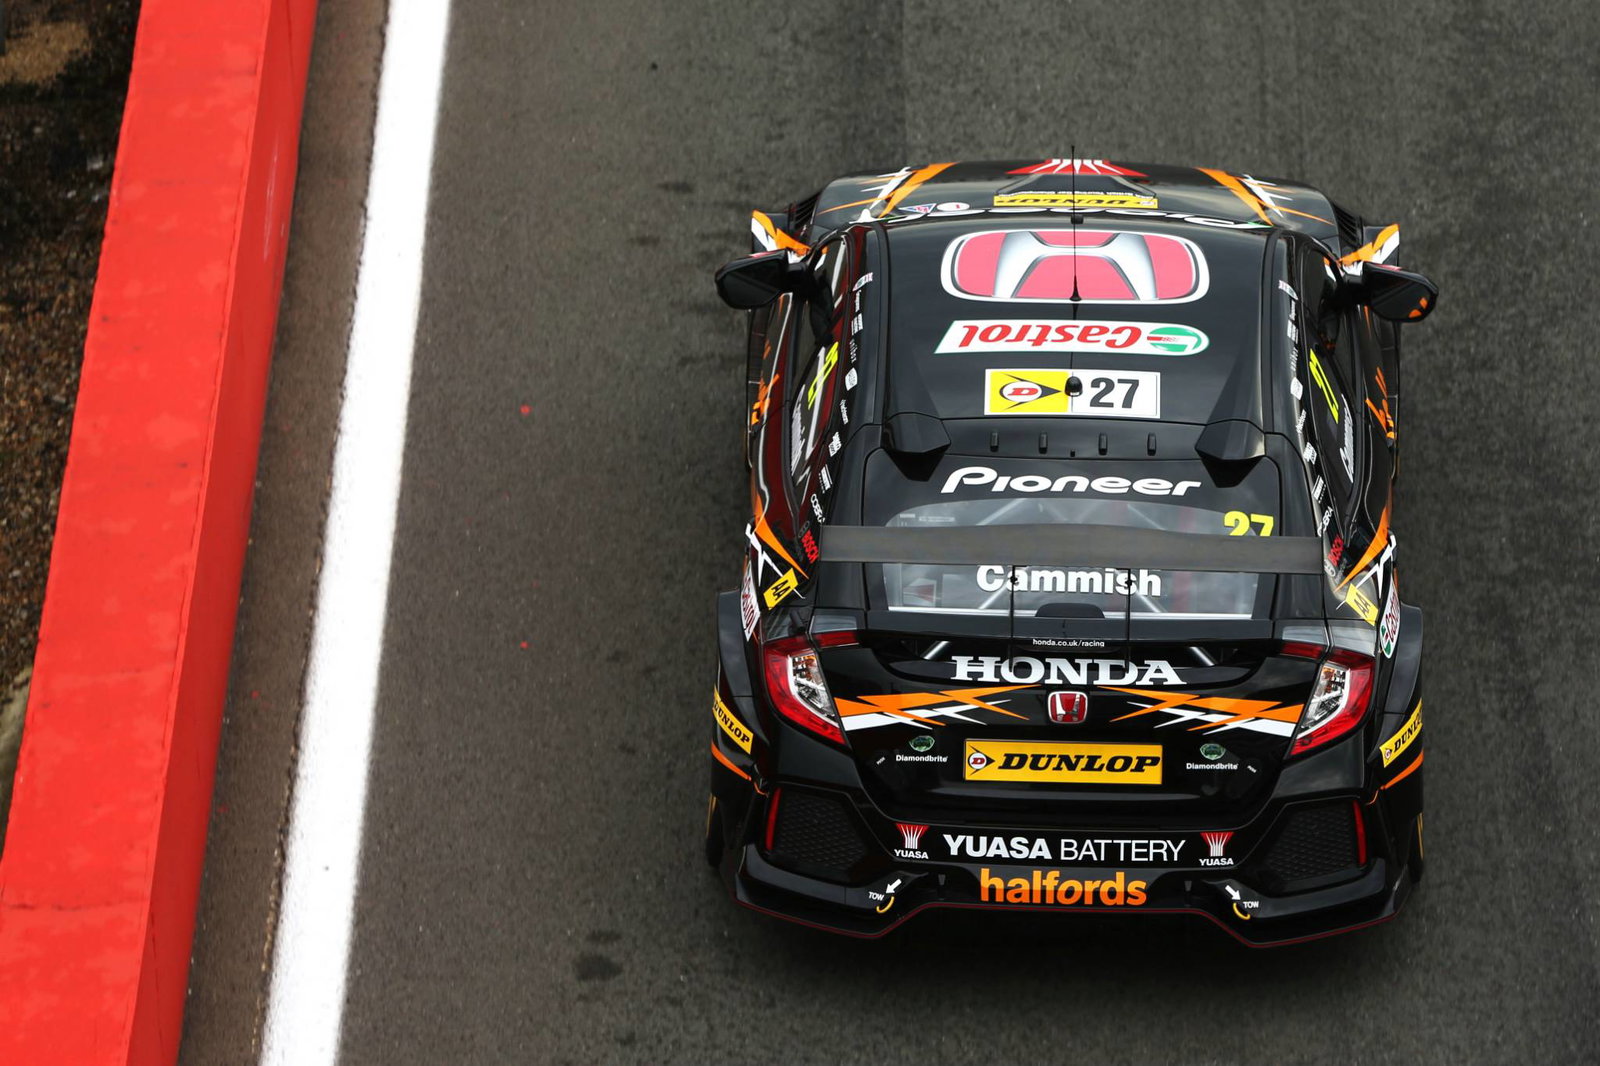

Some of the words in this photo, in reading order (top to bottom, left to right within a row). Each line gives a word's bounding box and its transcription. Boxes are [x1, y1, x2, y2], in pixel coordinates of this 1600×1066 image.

[958, 323, 1142, 349] Castrol
[1089, 377, 1140, 409] 27
[940, 466, 1202, 496] Pioneer
[1223, 510, 1275, 537] 27
[976, 564, 1162, 597] Cammish
[1032, 638, 1105, 647] honda.co.uk/racing
[950, 655, 1187, 686] HONDA
[713, 700, 751, 743] DUNLOP
[895, 754, 948, 763] Diamondbrite
[997, 753, 1161, 773] DUNLOP
[1186, 762, 1239, 770] Diamondbrite
[894, 849, 929, 860] YUASA
[942, 834, 1053, 860] YUASA
[1060, 839, 1187, 862] BATTERY
[1199, 858, 1234, 867] YUASA
[868, 892, 884, 901] TOW
[980, 868, 1147, 906] halfords
[1243, 901, 1259, 909] TOW
